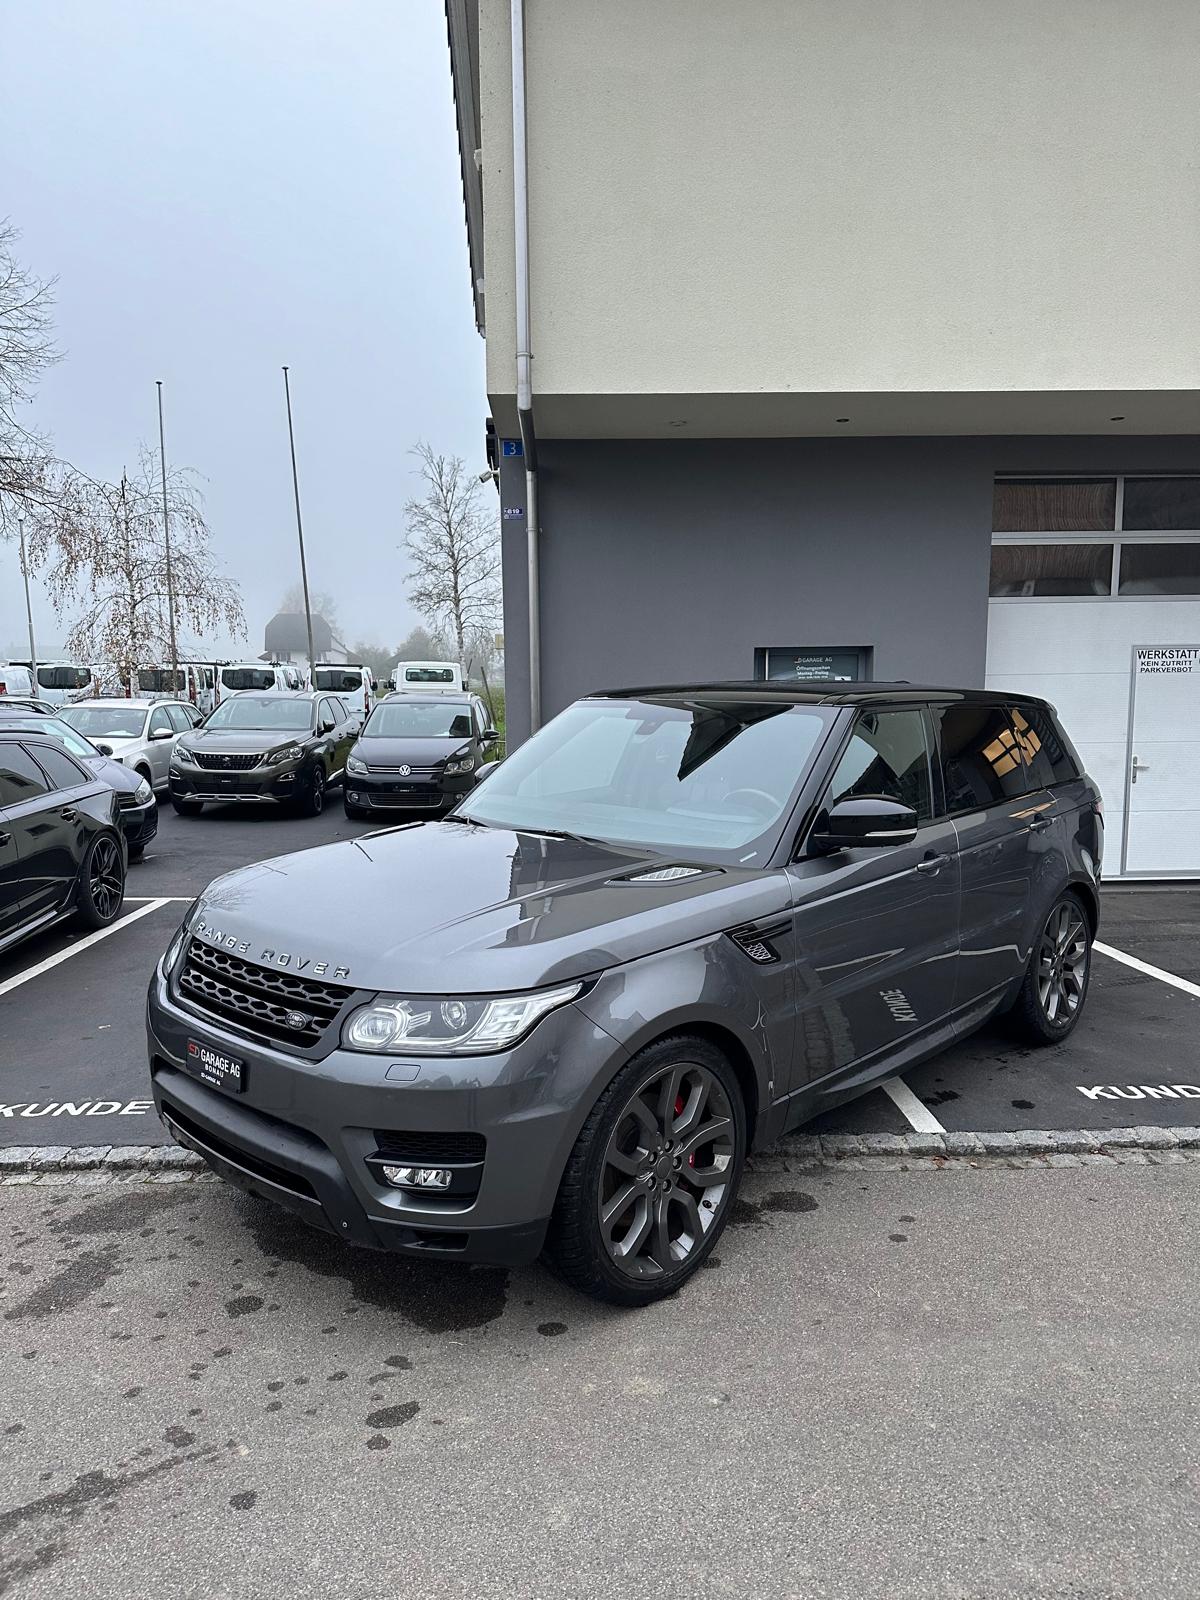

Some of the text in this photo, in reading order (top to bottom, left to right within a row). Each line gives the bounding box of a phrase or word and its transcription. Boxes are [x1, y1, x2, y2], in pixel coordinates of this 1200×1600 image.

[509, 442, 517, 455] 3
[1137, 650, 1199, 659] WERKSTATT
[196, 921, 350, 979] RANGE ROVER
[200, 1048, 229, 1073] GARAGE
[230, 1062, 240, 1078] AG
[0, 1101, 154, 1117] KUNDE
